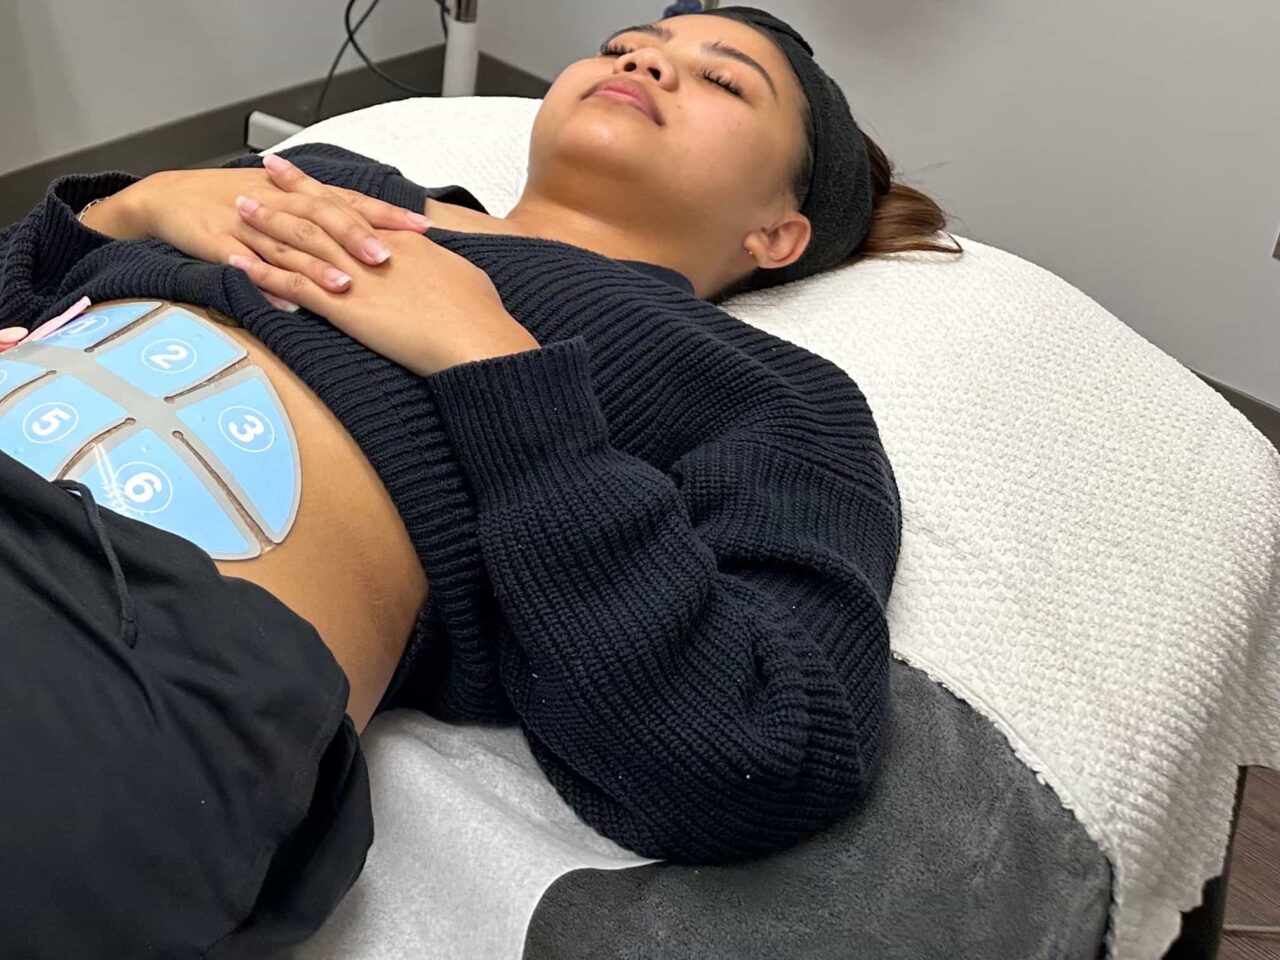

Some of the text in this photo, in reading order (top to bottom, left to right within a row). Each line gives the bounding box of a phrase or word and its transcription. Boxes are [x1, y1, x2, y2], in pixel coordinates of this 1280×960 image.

[149, 344, 188, 369] 2
[31, 407, 72, 436] 5
[228, 414, 264, 442] 3
[124, 471, 162, 503] 6
